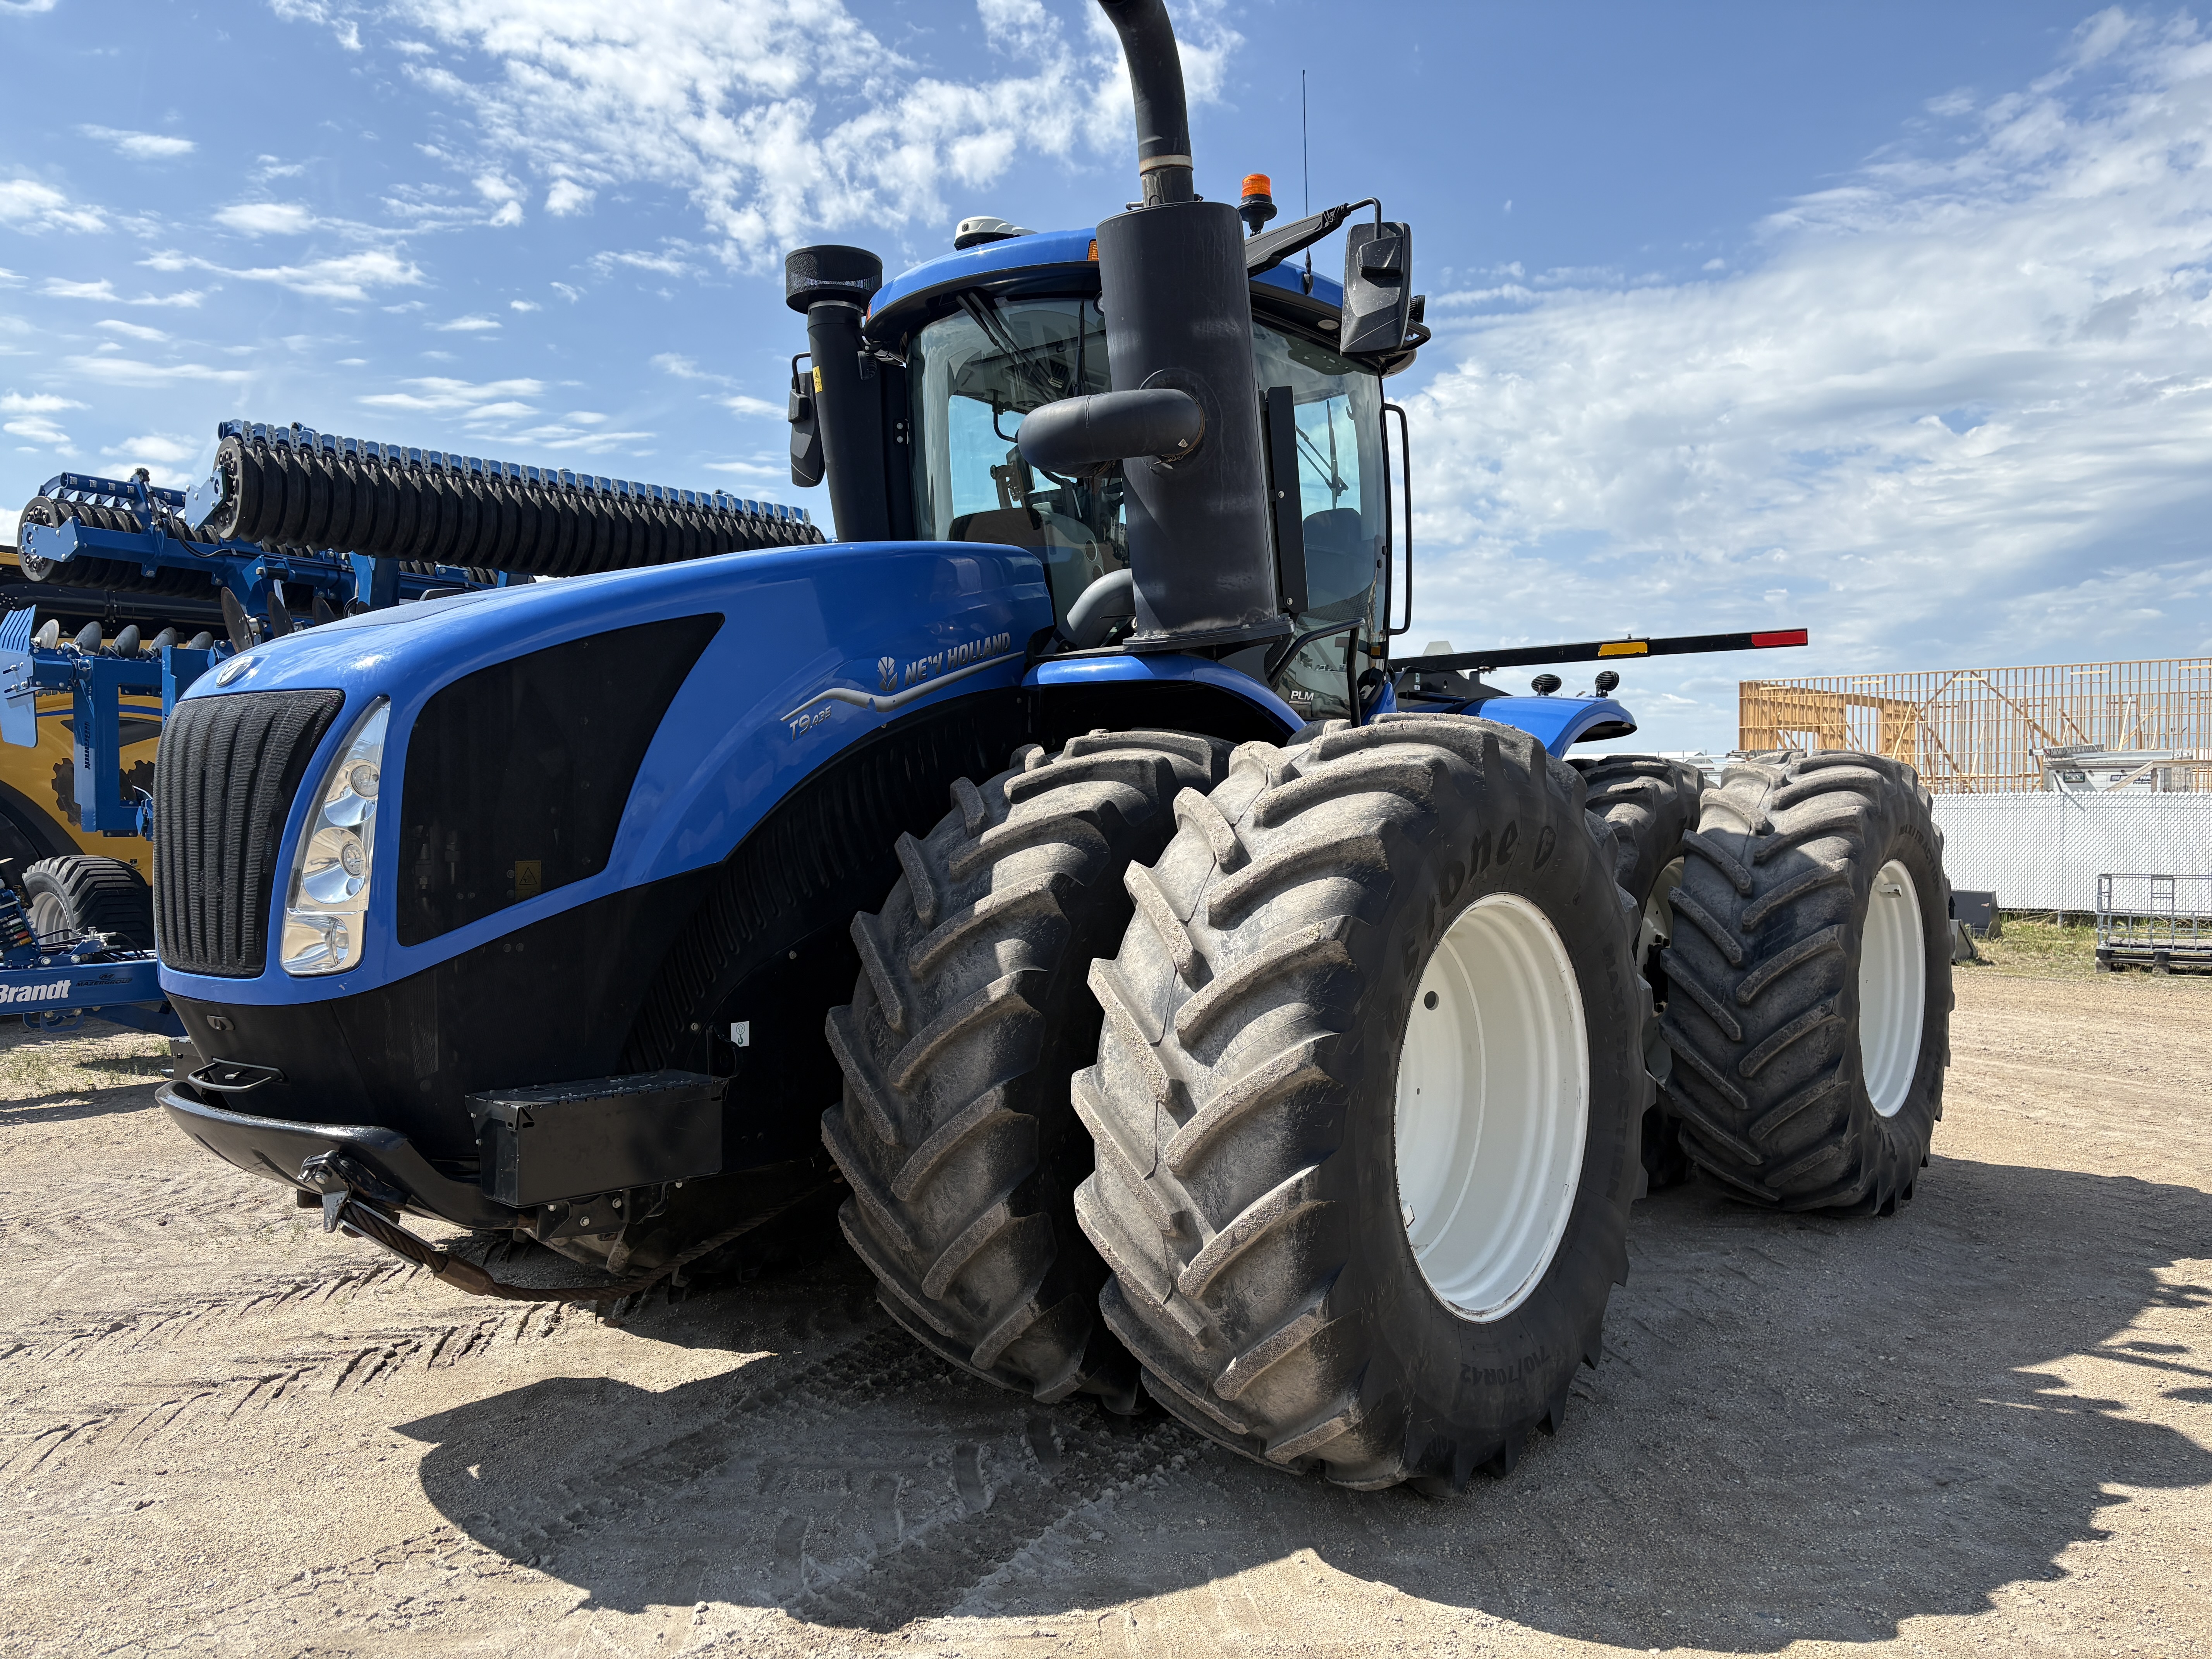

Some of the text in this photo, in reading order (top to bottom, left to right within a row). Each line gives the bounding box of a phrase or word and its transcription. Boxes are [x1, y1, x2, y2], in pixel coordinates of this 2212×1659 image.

[905, 632, 1010, 686] NEW HOLLAND
[1291, 690, 1314, 701] PLM
[1460, 1346, 1551, 1386] 710/70R42
